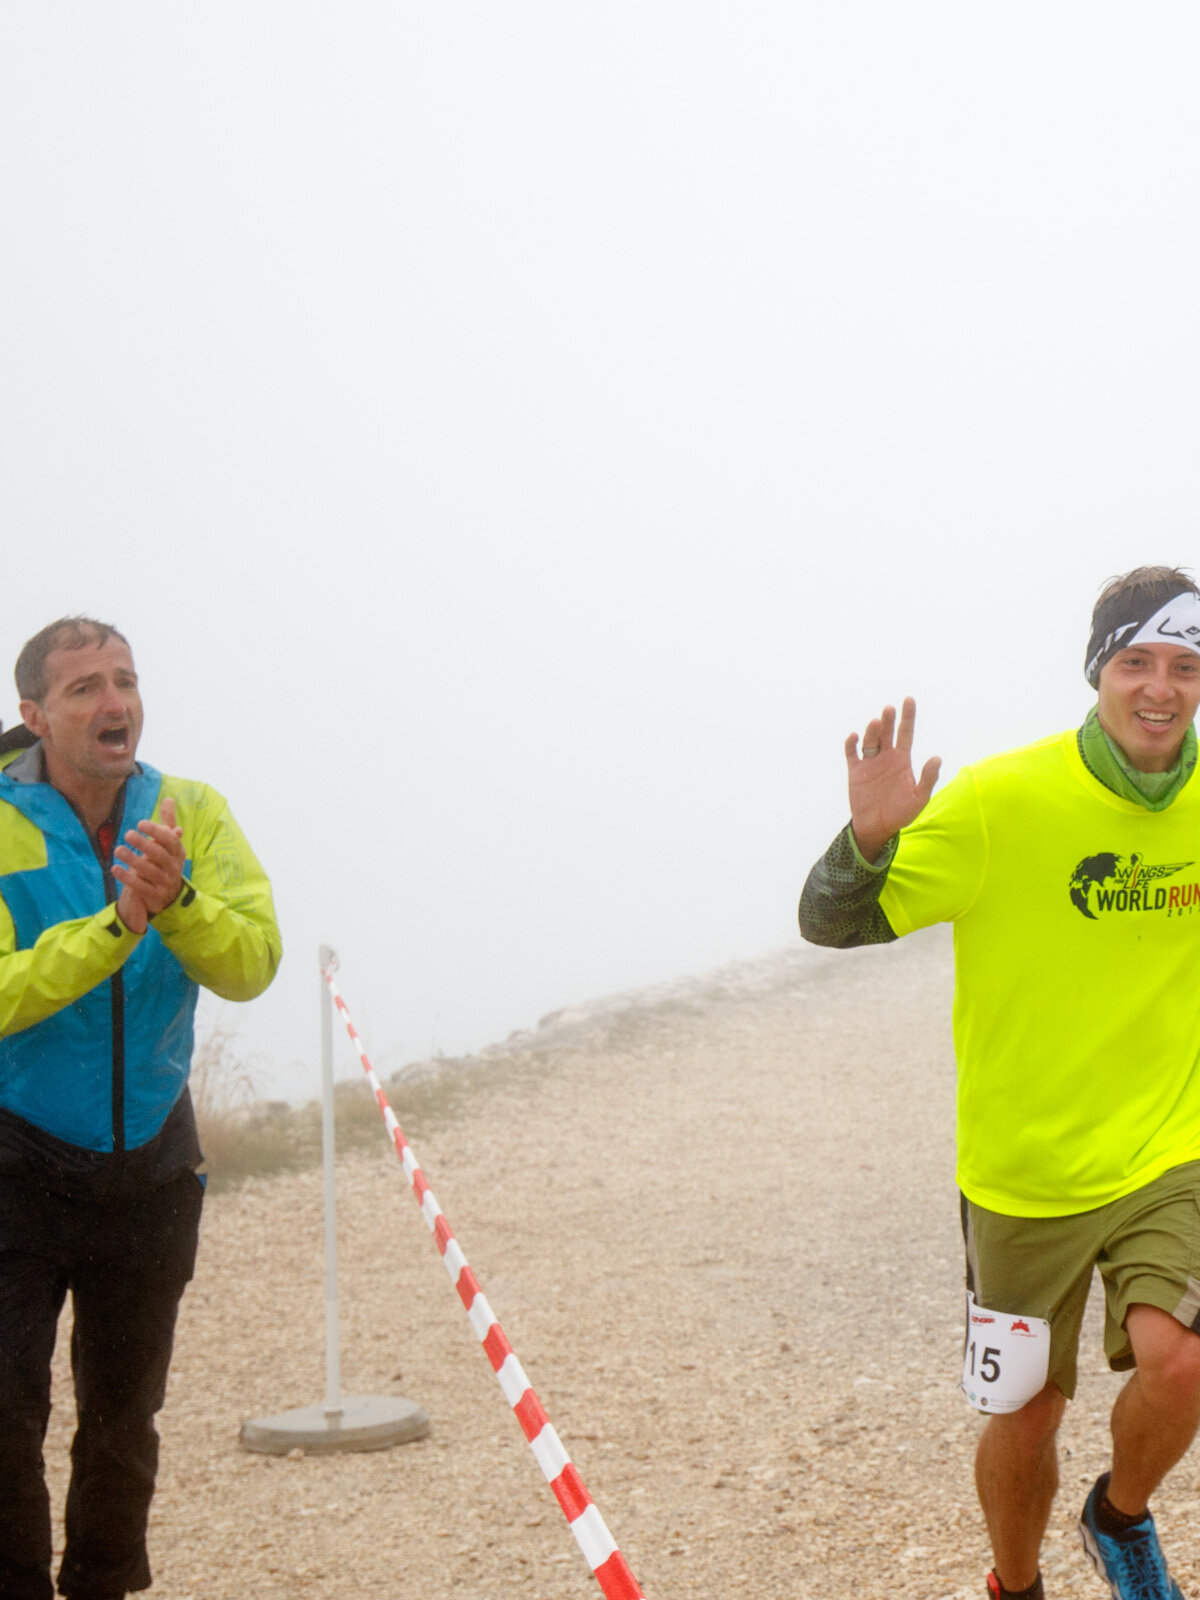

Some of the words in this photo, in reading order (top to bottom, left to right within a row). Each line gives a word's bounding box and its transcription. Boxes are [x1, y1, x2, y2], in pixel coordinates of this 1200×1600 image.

[1117, 864, 1166, 879] WINGS
[1123, 877, 1152, 890] LIFE
[1097, 887, 1167, 912] WORLD
[970, 1341, 1001, 1383] 15
